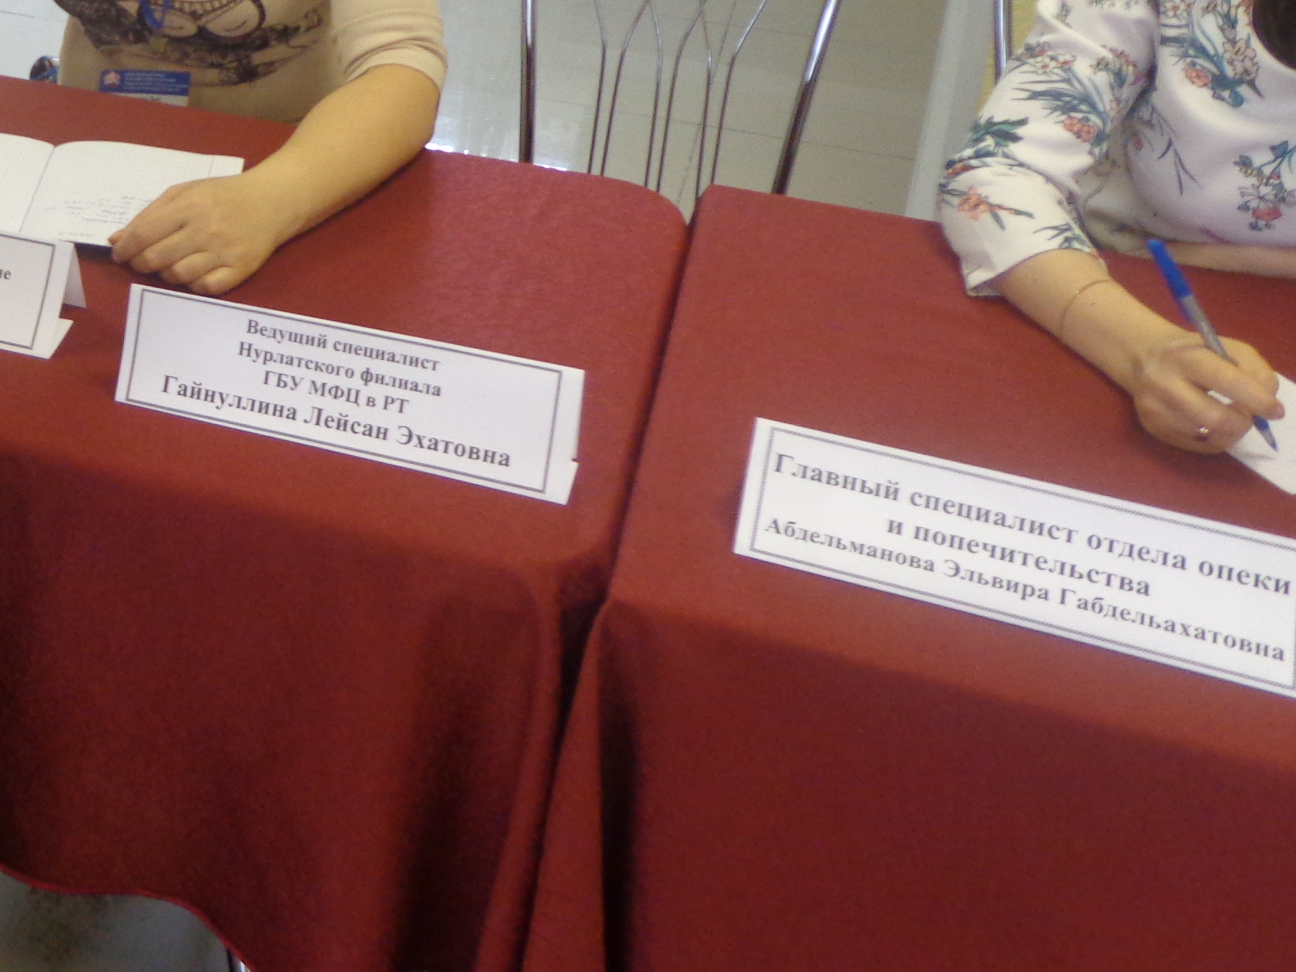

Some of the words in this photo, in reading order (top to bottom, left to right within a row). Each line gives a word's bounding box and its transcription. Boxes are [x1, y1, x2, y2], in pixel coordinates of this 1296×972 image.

[237, 340, 355, 380] Нурлатского
[359, 365, 442, 397] филиала
[246, 318, 327, 352] Ведущий
[332, 338, 441, 372] специалист
[161, 374, 298, 422] Гайнуллина
[303, 404, 389, 442] Лейсан
[396, 424, 511, 468] Эхатовна
[263, 370, 304, 392] ГБУ
[308, 378, 361, 407] МФЦ
[365, 395, 377, 407] в
[381, 395, 410, 415] РТ
[773, 451, 901, 502] Главный
[908, 489, 1079, 545] специалист
[1086, 532, 1188, 571] отдела
[1197, 559, 1292, 596] опеки
[886, 517, 904, 536] и
[913, 521, 1152, 598] попечительства
[764, 516, 936, 574] Абдельманова
[941, 557, 1051, 604] Эльвира
[1058, 586, 1285, 663] Габдельахатовна
